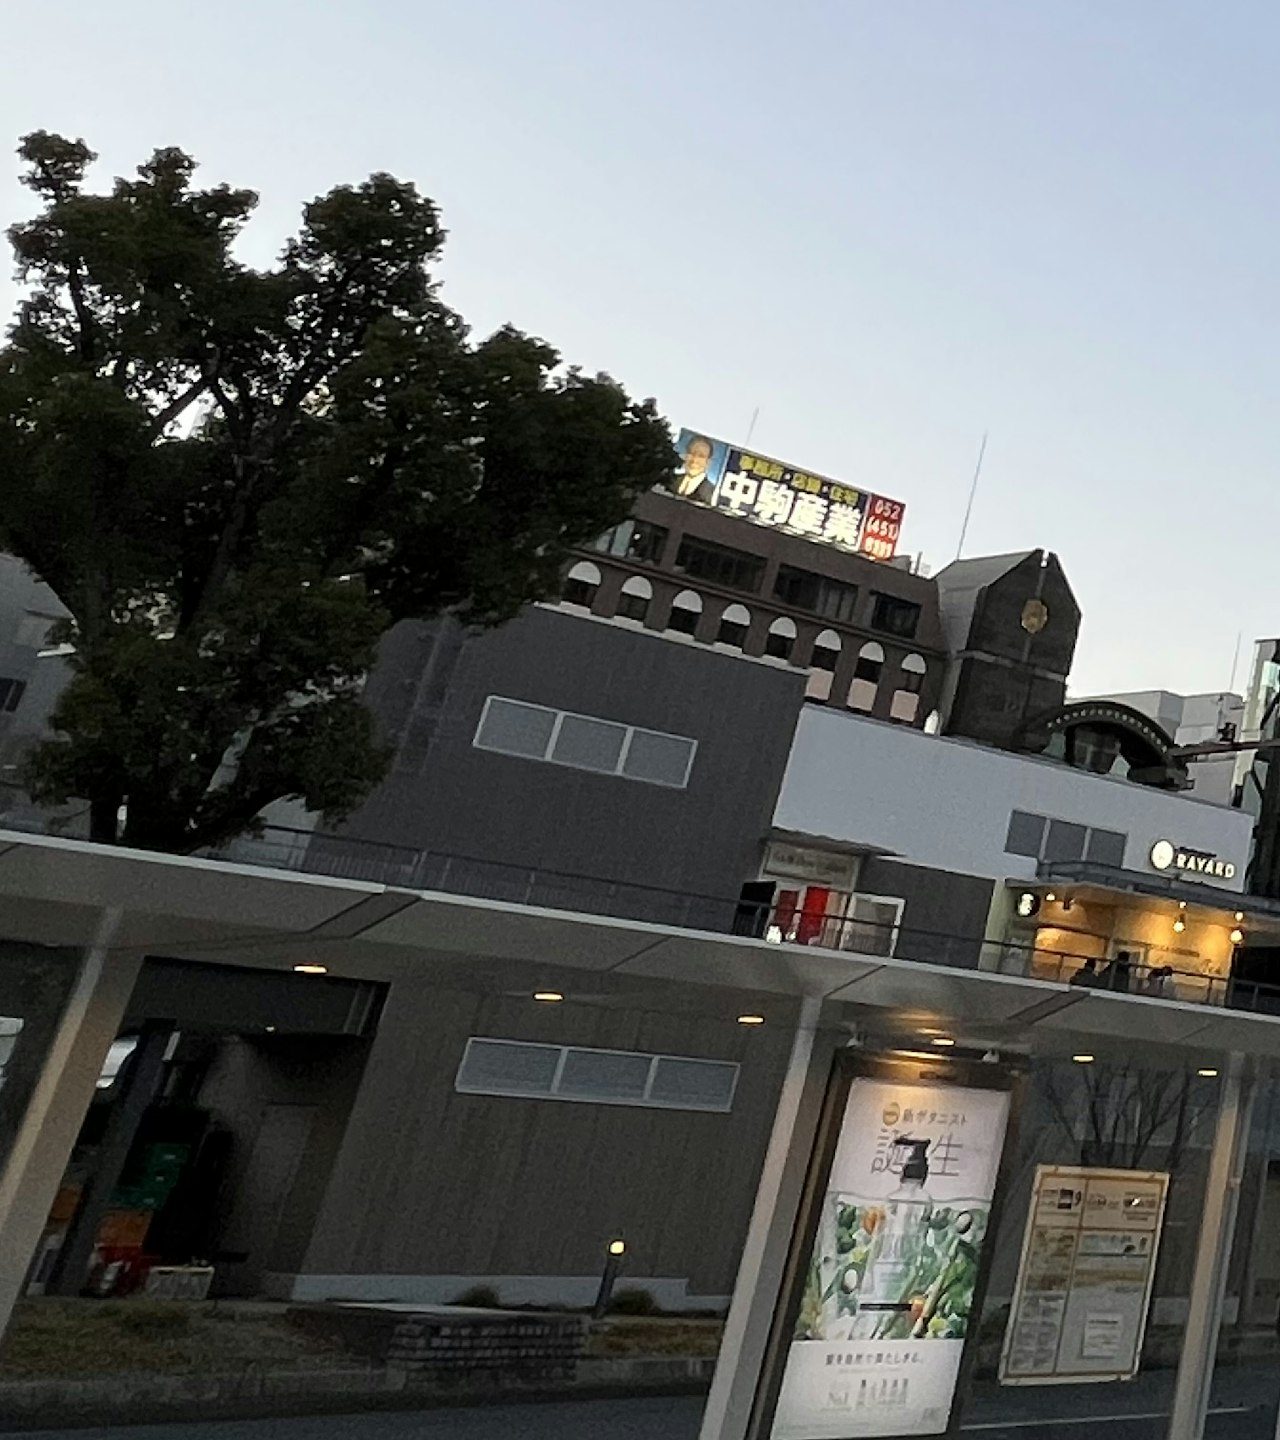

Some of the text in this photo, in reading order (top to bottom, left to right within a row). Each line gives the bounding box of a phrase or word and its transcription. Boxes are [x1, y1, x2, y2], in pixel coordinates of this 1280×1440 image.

[720, 471, 863, 545] 中駒産業
[874, 499, 901, 520] 052
[1176, 853, 1236, 878] RAYARD
